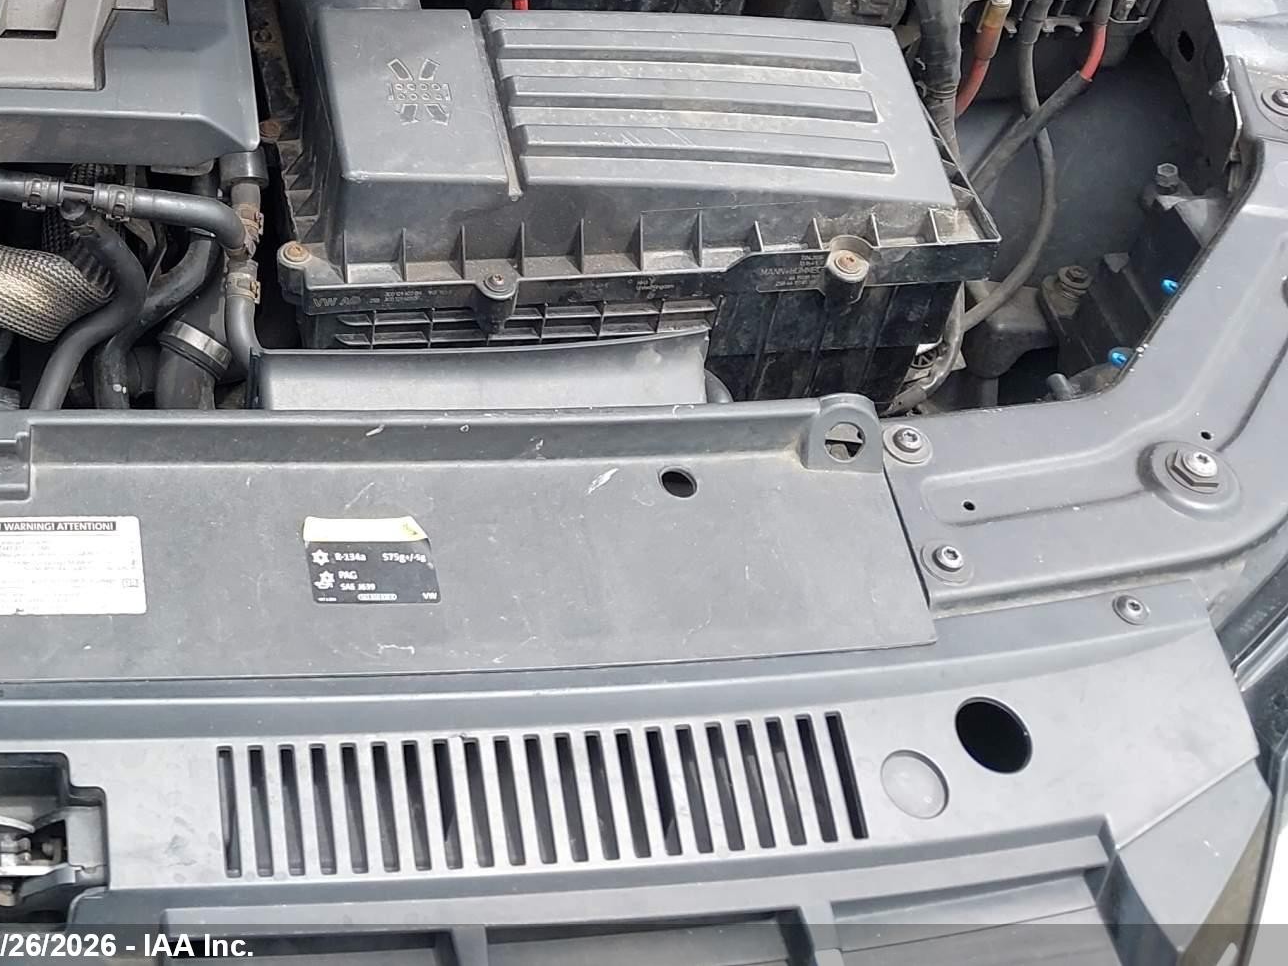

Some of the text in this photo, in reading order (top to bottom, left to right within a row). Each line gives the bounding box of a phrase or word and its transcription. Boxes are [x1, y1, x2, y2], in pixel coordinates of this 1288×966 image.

[4, 522, 55, 532] WARNING!
[57, 521, 114, 532] ATTENTION!
[334, 552, 367, 562] R-134a
